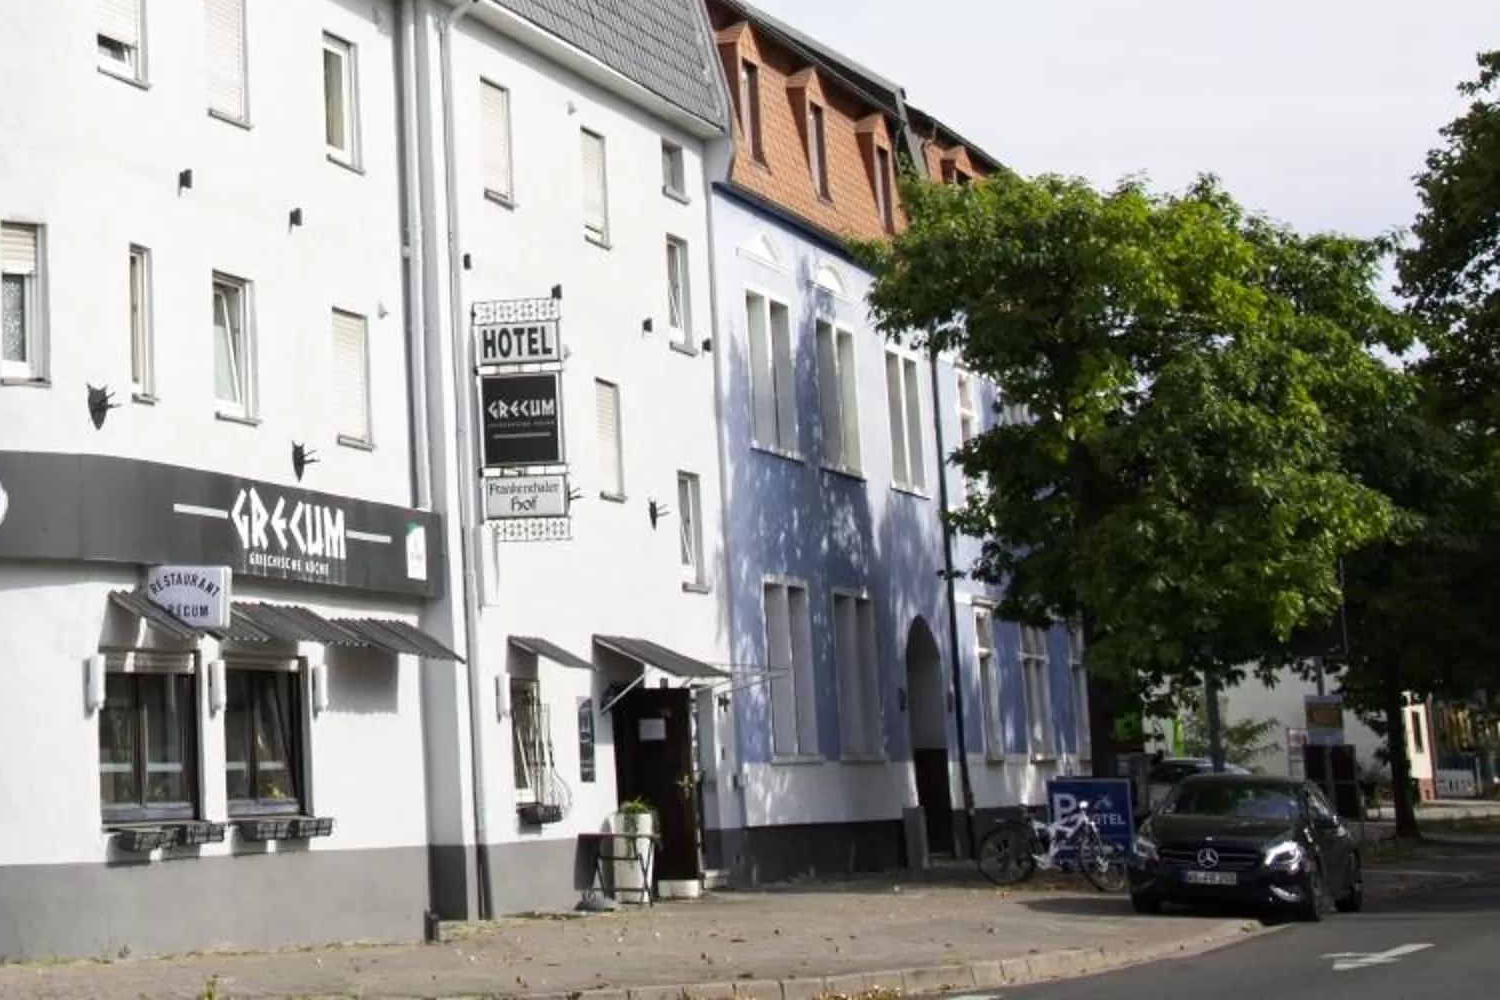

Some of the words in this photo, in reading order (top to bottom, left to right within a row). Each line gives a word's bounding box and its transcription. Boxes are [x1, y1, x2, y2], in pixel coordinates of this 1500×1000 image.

[483, 325, 553, 359] HOTEL
[487, 398, 555, 420] GRECUM
[231, 487, 347, 560] GRECUM
[150, 572, 221, 597] RESTAURANT
